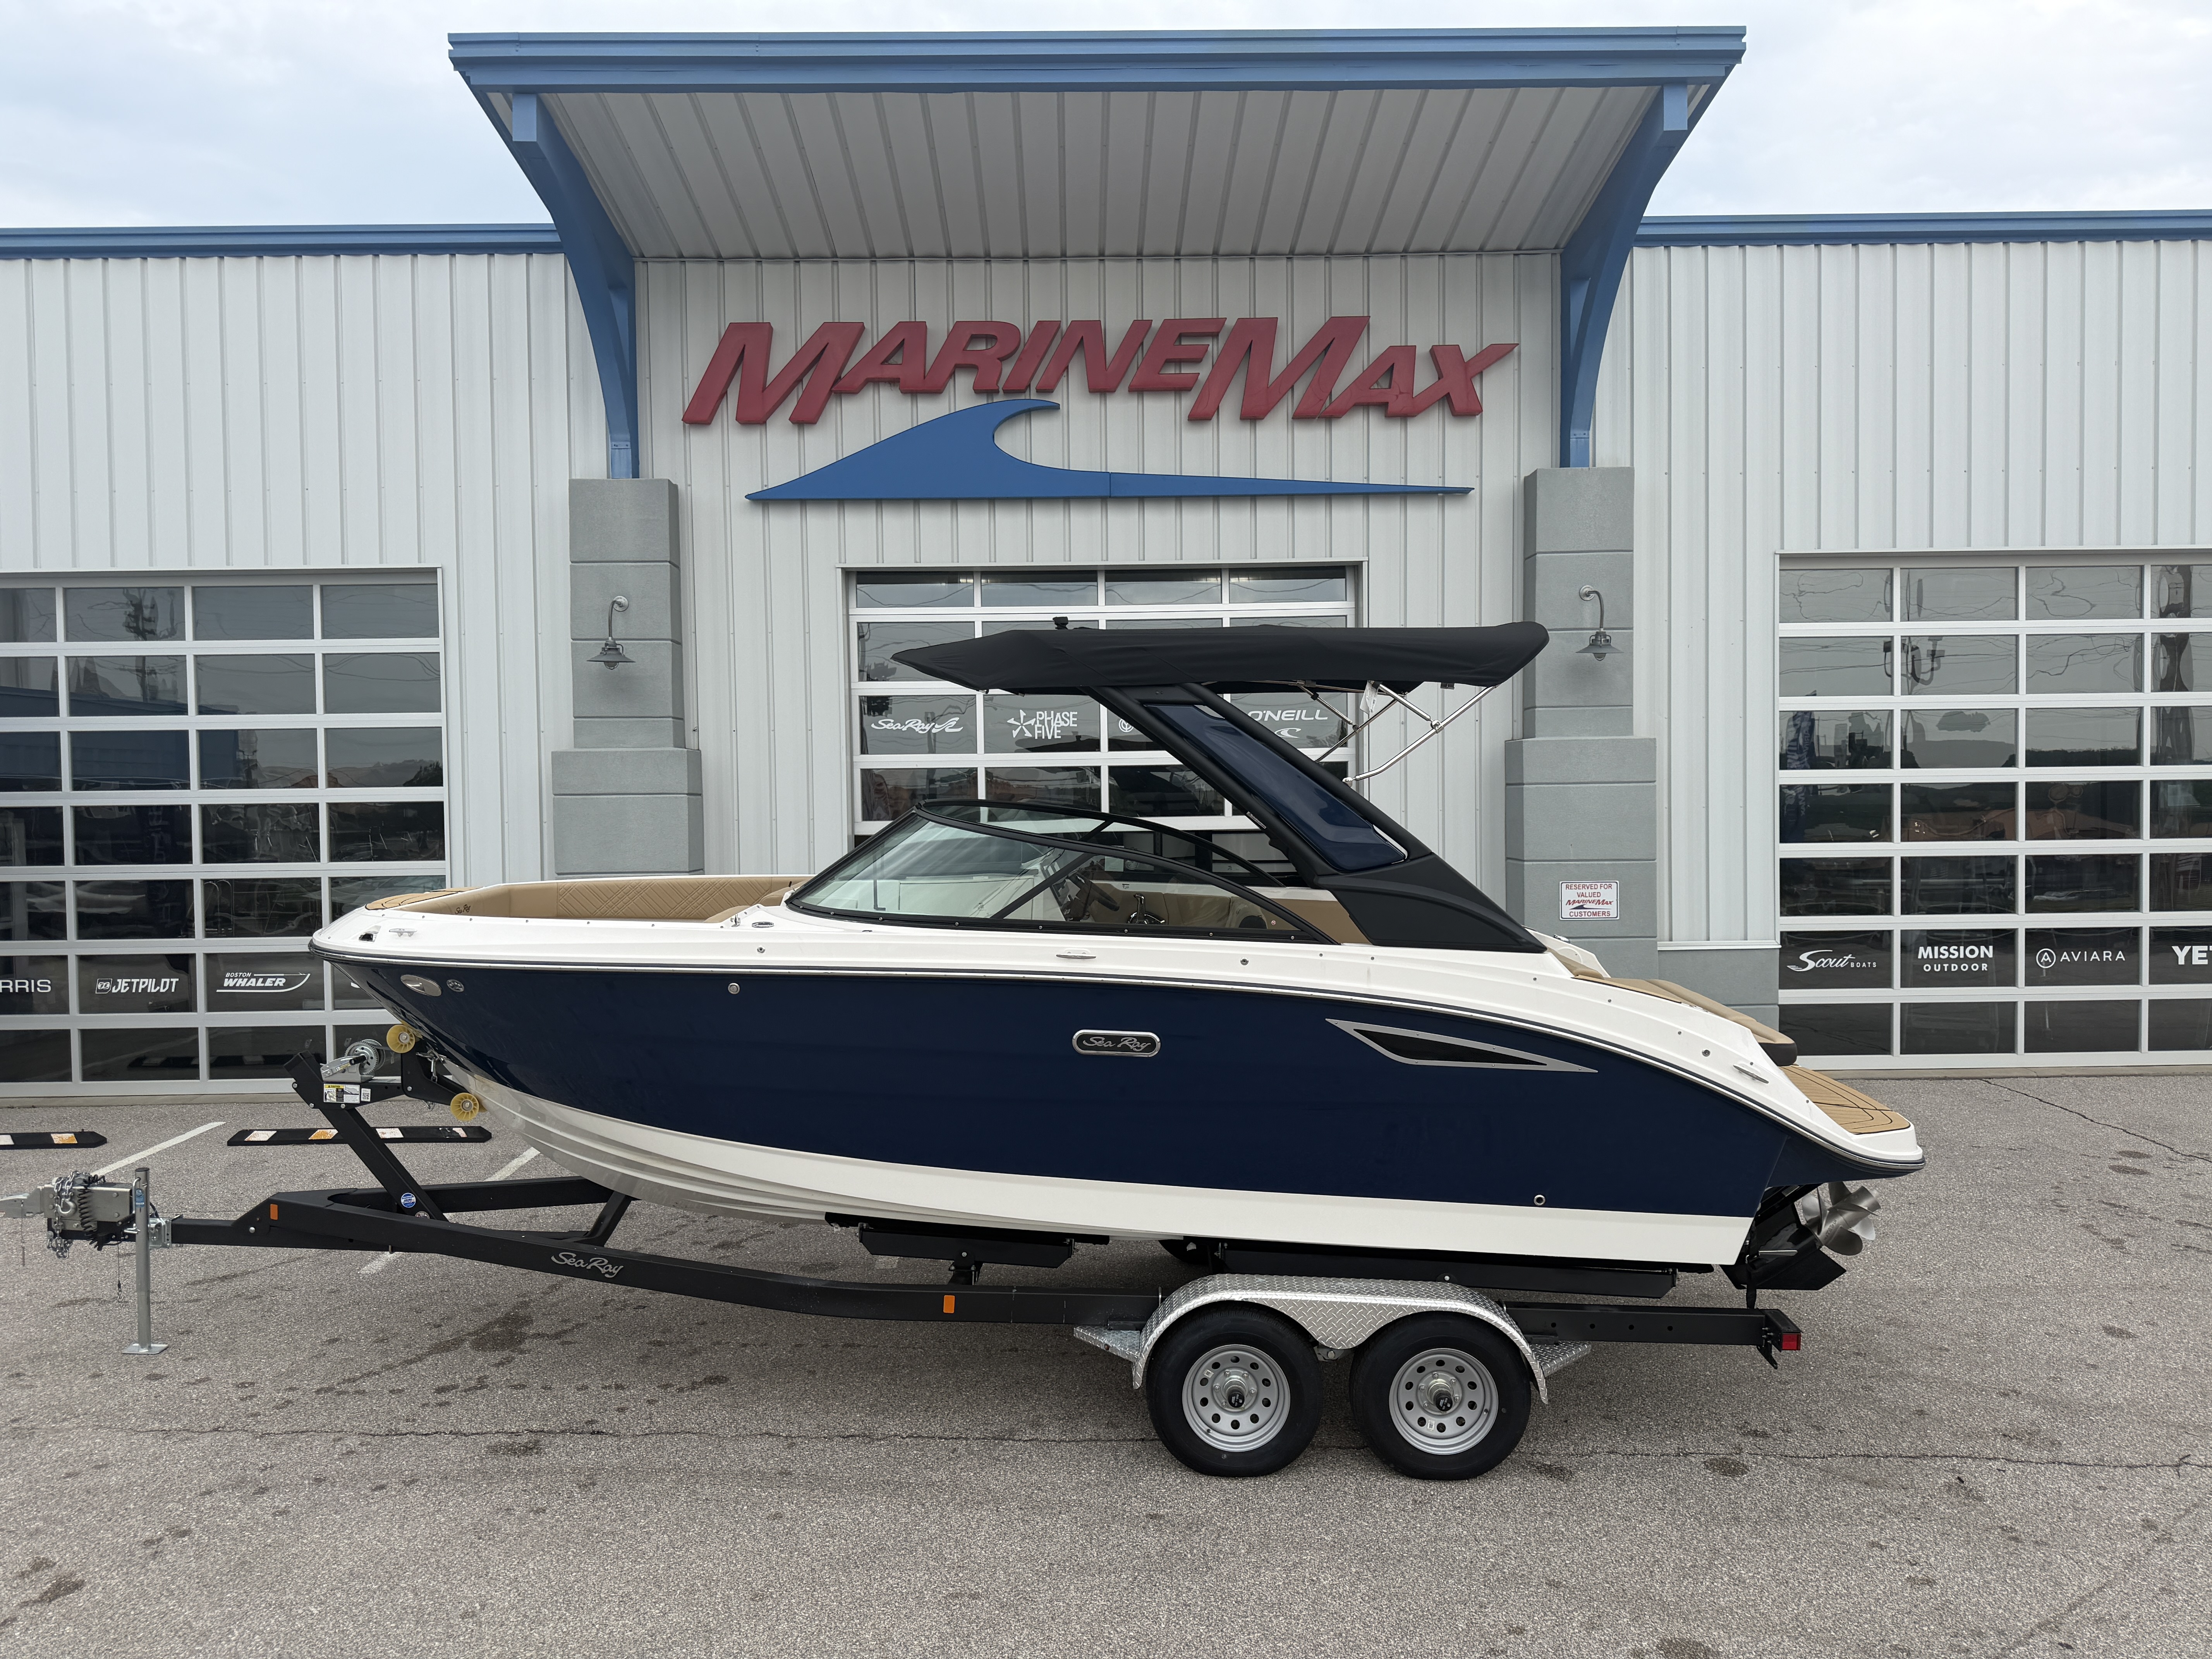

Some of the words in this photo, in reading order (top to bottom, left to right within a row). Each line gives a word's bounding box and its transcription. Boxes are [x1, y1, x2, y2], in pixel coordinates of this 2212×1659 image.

[682, 316, 1519, 424] MARINEMAX
[1036, 711, 1077, 726] PHASE
[1248, 709, 1328, 721] O'NEILL
[871, 719, 904, 730] Sea
[902, 719, 935, 734] Ray
[1035, 725, 1061, 739] FIVE
[1918, 945, 1993, 959] MISSION
[2060, 951, 2126, 962] AVIARA
[2171, 945, 2212, 965] YE
[1786, 950, 1856, 972] Scout
[1923, 963, 1988, 972] OUTDOOR
[112, 978, 179, 993] JETPILOT
[223, 978, 286, 987] WHALER
[1083, 1037, 1116, 1047] Sea
[1117, 1037, 1151, 1052] Ray
[551, 1252, 588, 1267] Sea
[586, 1257, 624, 1278] Ray
